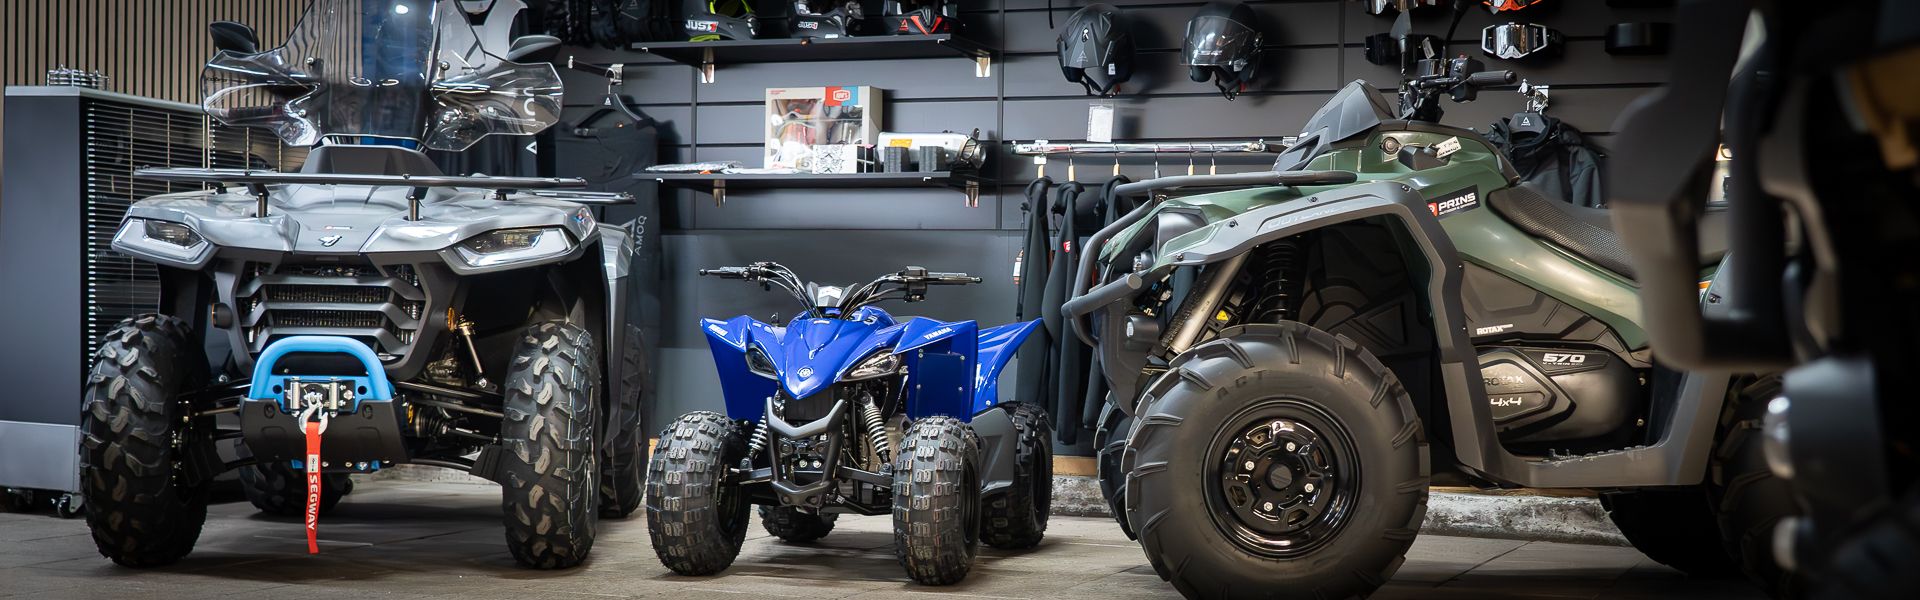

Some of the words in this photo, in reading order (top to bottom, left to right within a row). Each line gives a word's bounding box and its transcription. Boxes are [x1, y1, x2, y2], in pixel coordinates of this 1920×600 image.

[1438, 192, 1476, 211] PRINS
[633, 215, 648, 256] AMOQ
[1476, 325, 1505, 336] ROTAX
[1542, 353, 1586, 363] 570
[1490, 397, 1522, 407] 4x4
[307, 474, 318, 530] SEGWAY
